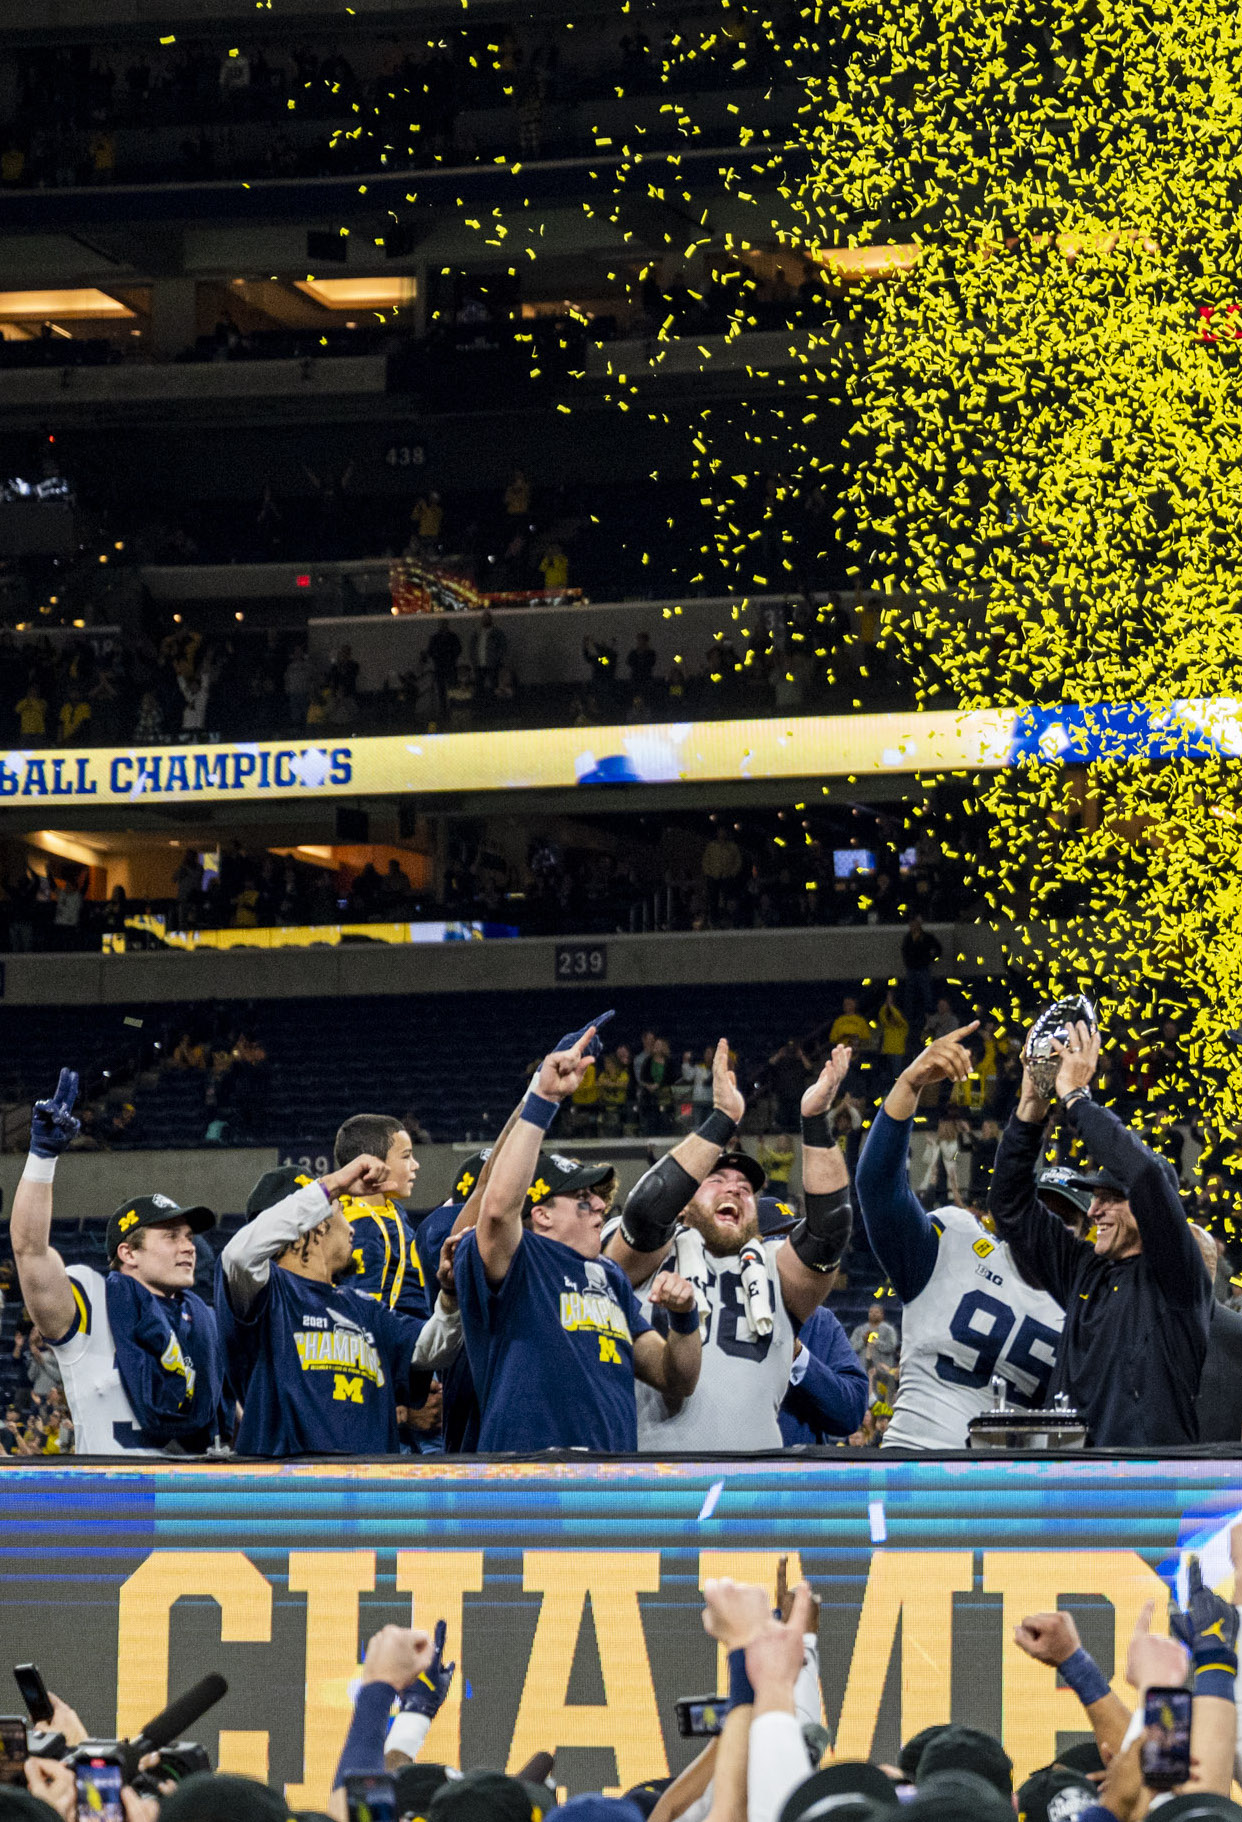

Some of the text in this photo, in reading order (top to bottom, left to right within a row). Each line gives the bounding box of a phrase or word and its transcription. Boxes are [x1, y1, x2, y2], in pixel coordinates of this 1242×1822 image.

[385, 446, 424, 466] 438
[110, 748, 353, 794] CHAMPIOS
[559, 951, 602, 973] 239
[526, 1177, 551, 1203] M
[118, 1209, 140, 1232] M
[302, 1314, 329, 1329] 2021
[598, 1334, 623, 1365] M
[934, 1288, 1062, 1409] 95
[332, 1373, 365, 1404] M
